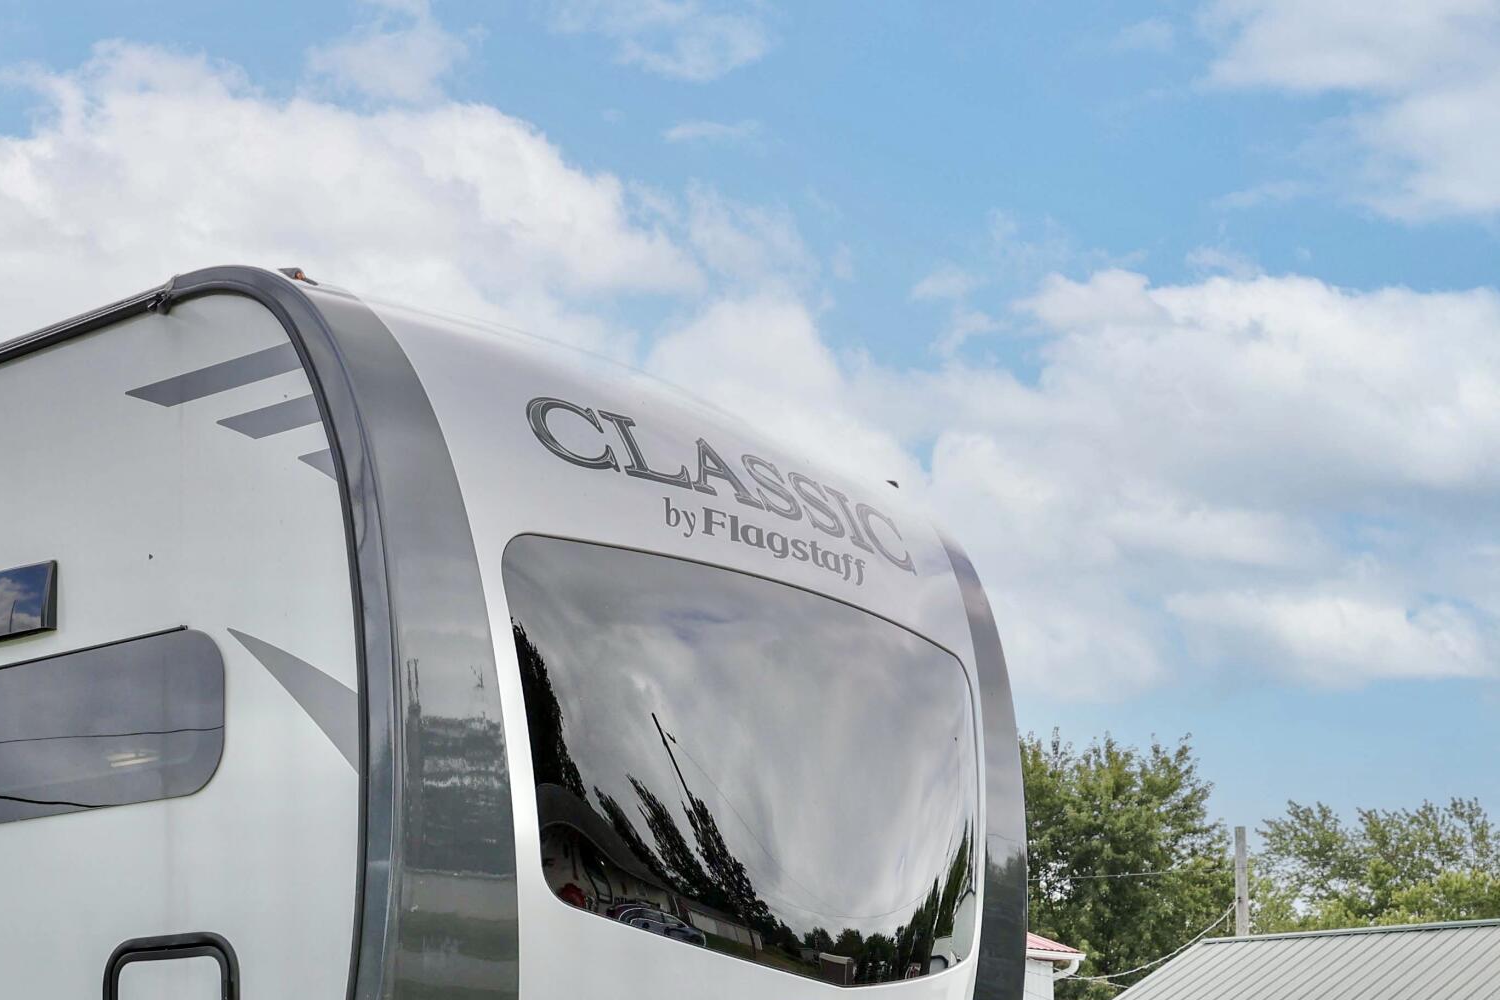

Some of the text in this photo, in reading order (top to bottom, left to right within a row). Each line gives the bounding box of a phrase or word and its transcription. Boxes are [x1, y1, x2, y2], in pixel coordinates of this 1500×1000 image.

[525, 396, 918, 576] CLASSIC
[663, 497, 866, 586] by Flagstaff
